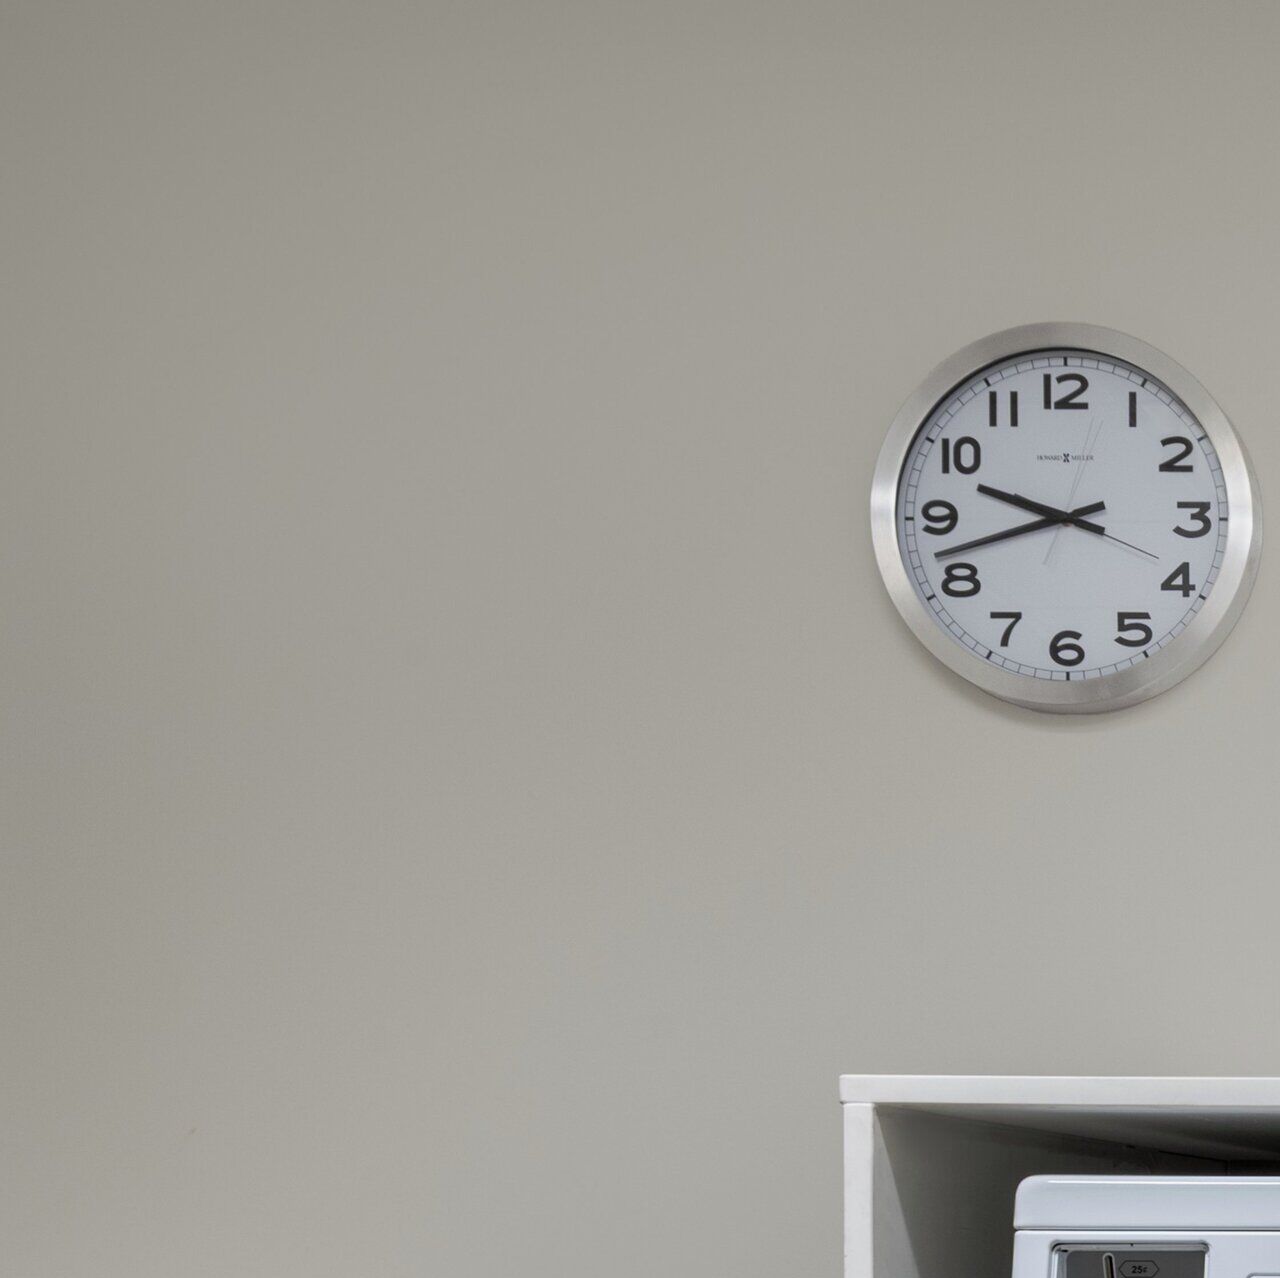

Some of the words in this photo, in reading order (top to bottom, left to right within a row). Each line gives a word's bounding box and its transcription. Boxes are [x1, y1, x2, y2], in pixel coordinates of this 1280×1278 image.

[989, 391, 1018, 427] 11
[1043, 373, 1089, 410] 12
[1129, 392, 1137, 427] 1
[942, 436, 981, 474] 10
[1159, 436, 1194, 472] 2
[921, 500, 959, 535] 9
[1172, 501, 1212, 538] 3
[941, 562, 981, 598] 8
[1160, 561, 1196, 598] 4
[990, 611, 1022, 647] 7
[1114, 611, 1153, 647] 5
[1049, 630, 1085, 667] 6
